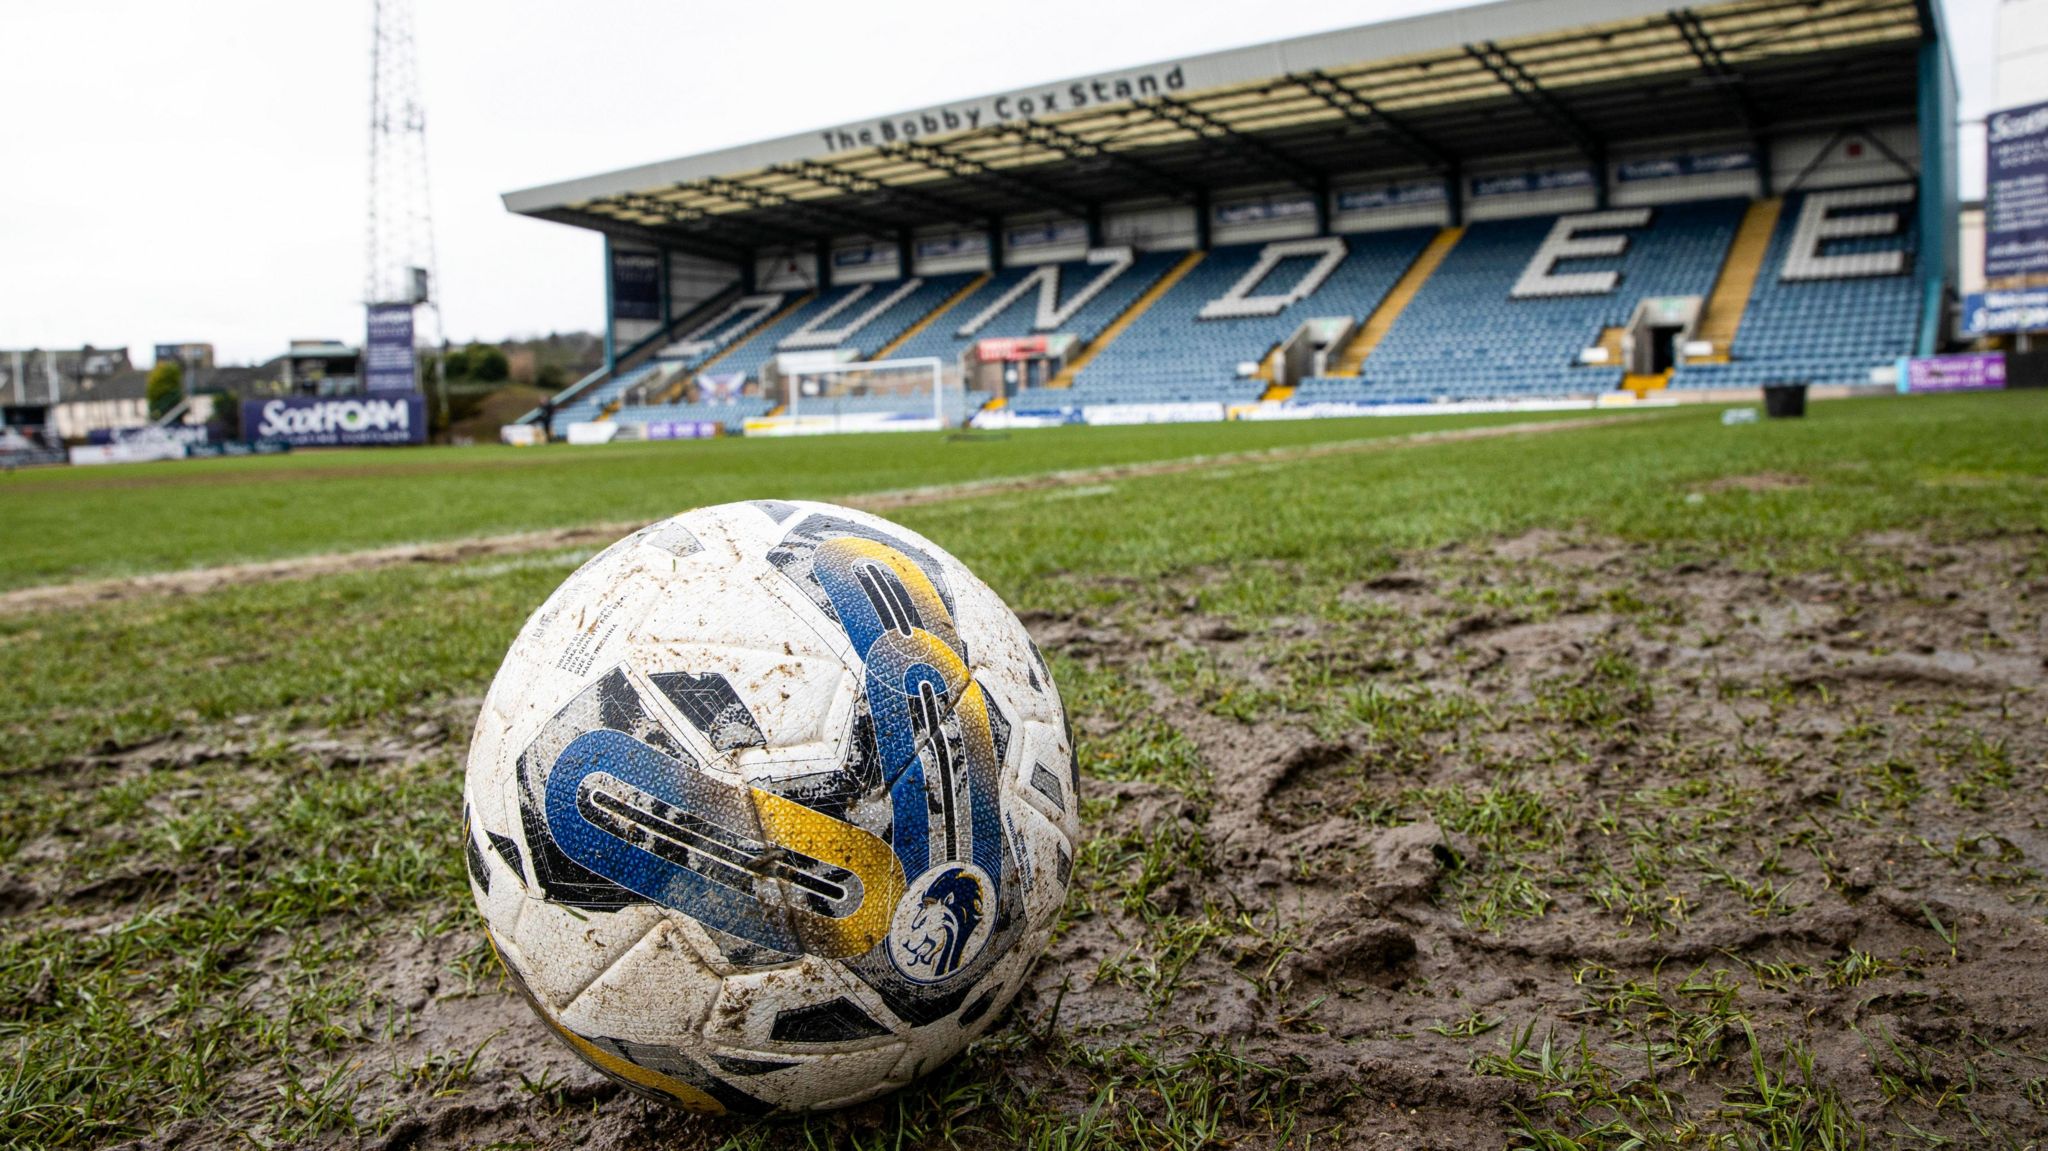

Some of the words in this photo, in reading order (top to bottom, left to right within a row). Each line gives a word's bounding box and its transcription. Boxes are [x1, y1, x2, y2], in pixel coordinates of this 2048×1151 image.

[822, 125, 873, 153] The
[880, 107, 981, 142] Bobby
[994, 95, 1056, 120] Cox
[1069, 65, 1185, 107] Stand
[562, 648, 578, 670] PUMA
[568, 656, 580, 673] FIFA
[579, 624, 601, 655] QUALITY
[574, 660, 588, 675] SIZE
[580, 655, 597, 678] MADE
